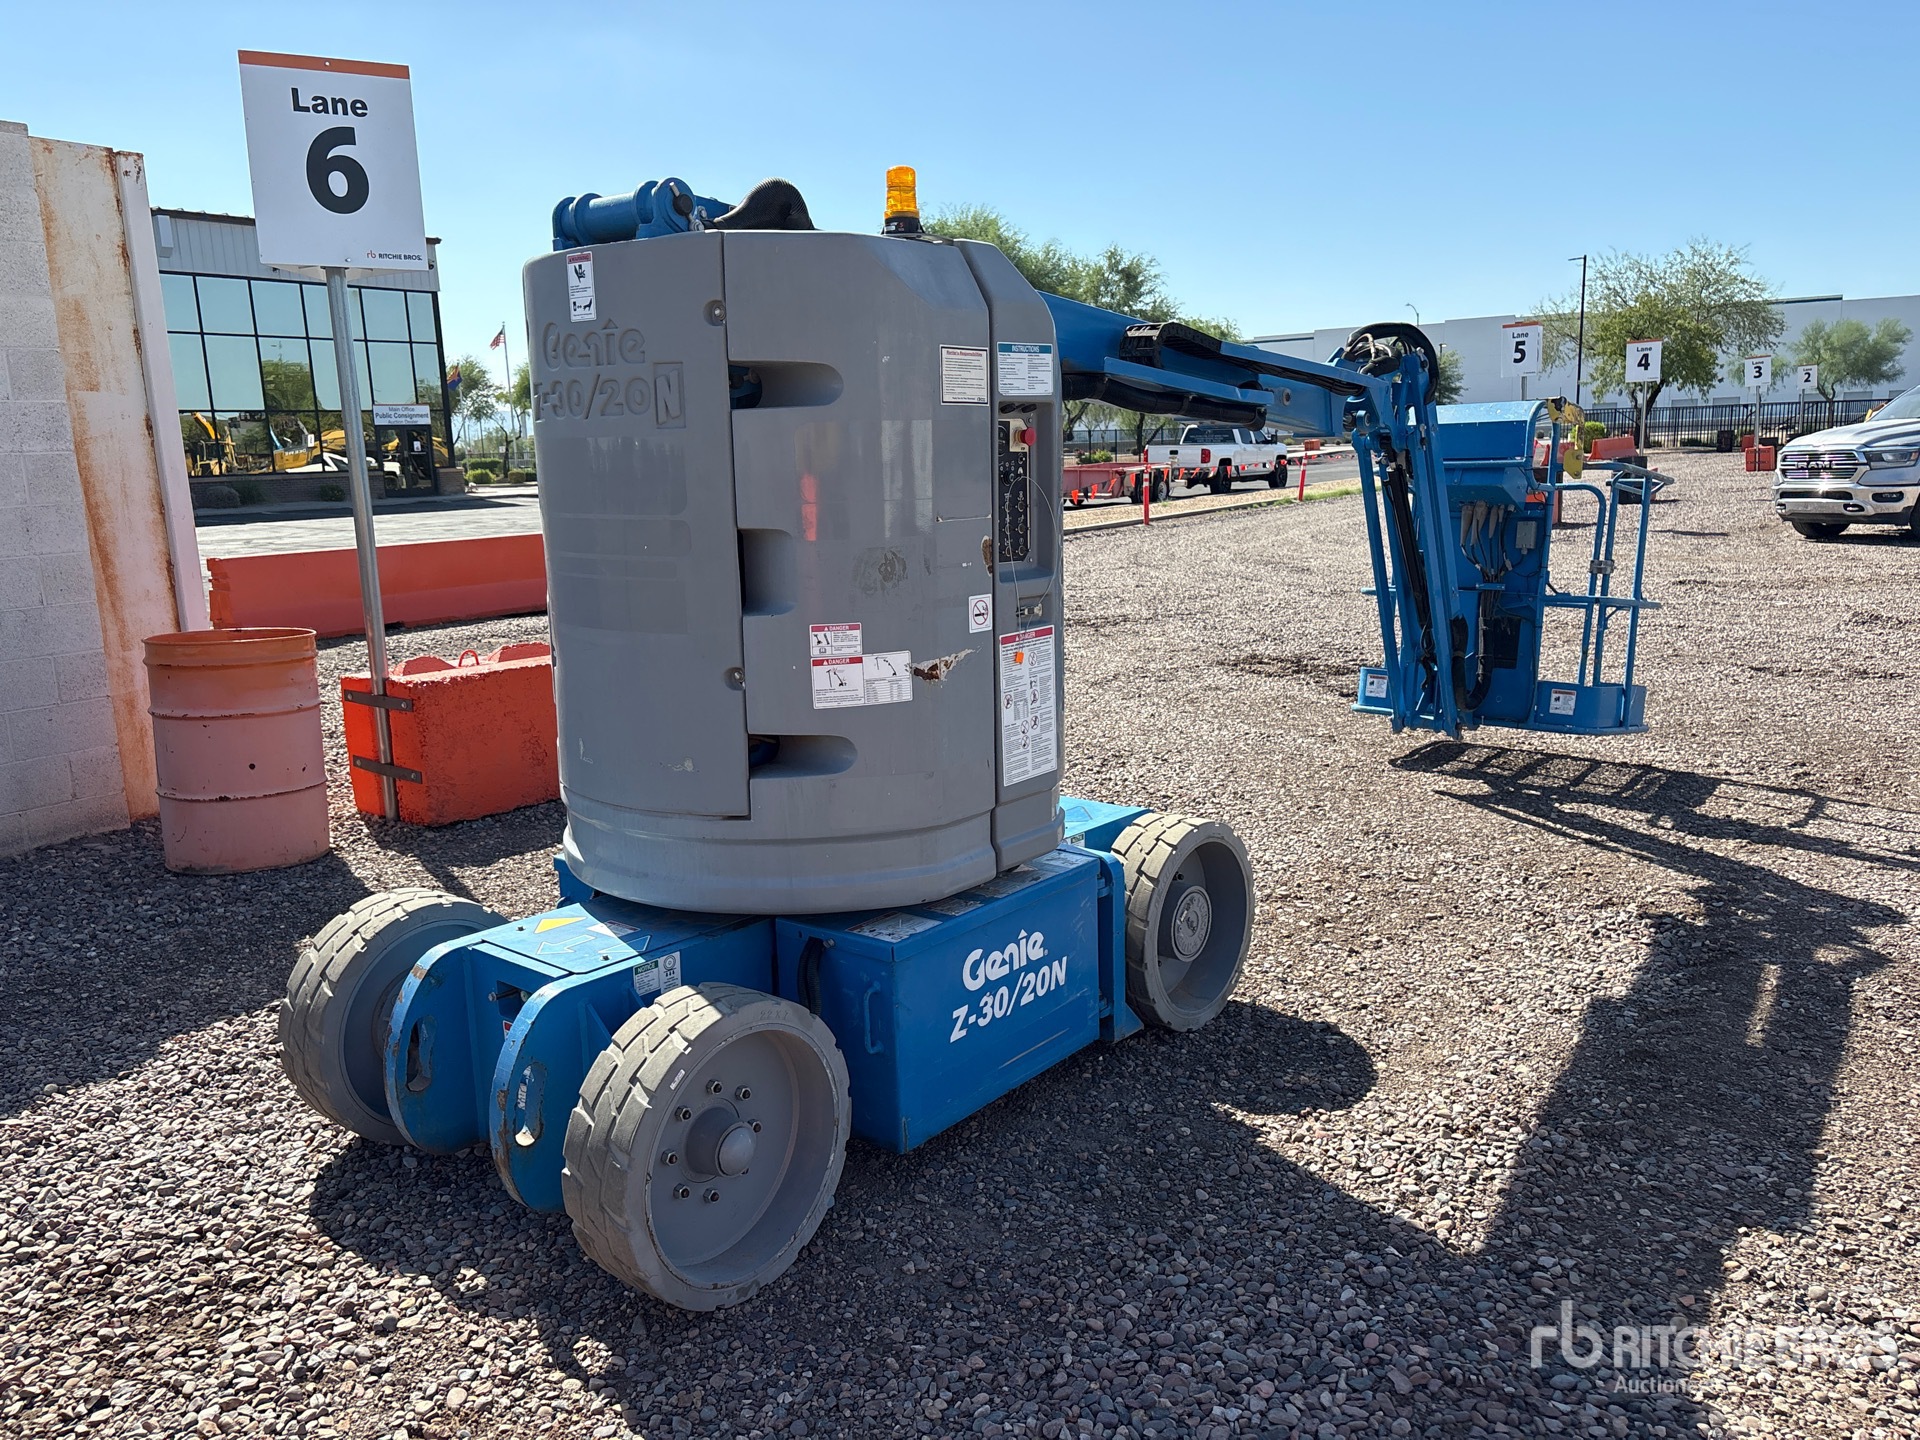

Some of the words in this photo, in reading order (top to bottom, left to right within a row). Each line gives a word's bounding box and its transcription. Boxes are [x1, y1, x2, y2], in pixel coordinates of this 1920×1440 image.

[291, 87, 368, 117] Lane
[306, 126, 369, 214] 6
[542, 317, 646, 372] Genie
[1011, 345, 1040, 353] INSTRUCTIONS
[1513, 340, 1526, 364] 5
[1637, 353, 1651, 371] 4
[1753, 366, 1763, 379] 3
[1803, 372, 1811, 383] 2
[1797, 461, 1831, 469] RAM
[637, 962, 656, 973] NOTICE
[962, 928, 1045, 991] Genie
[950, 955, 1068, 1044] Z-30/20N
